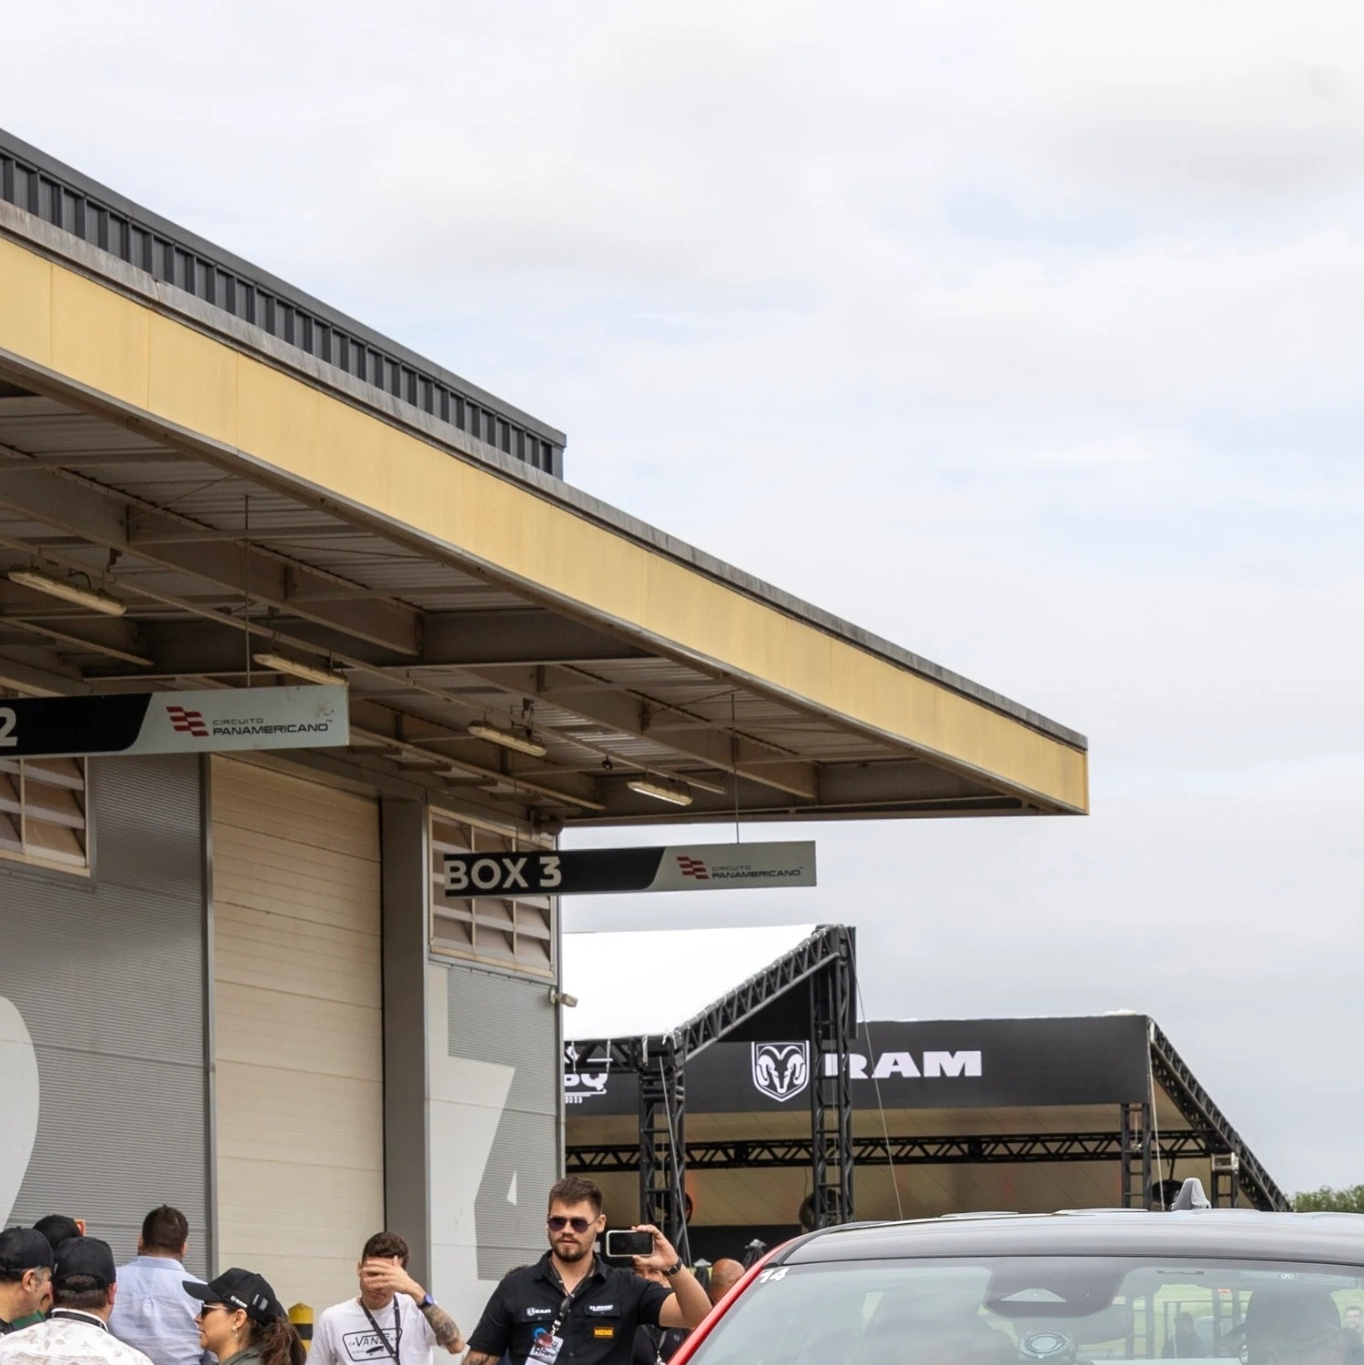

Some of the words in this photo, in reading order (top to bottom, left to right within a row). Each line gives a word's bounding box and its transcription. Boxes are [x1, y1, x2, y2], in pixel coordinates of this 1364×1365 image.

[0, 707, 18, 746] 2
[212, 717, 264, 725] CIRCUITO
[213, 723, 329, 736] PANAMERICANO
[444, 857, 529, 890] BOX
[539, 856, 562, 887] 3
[824, 1050, 983, 1079] RAM
[760, 1266, 790, 1284] 14
